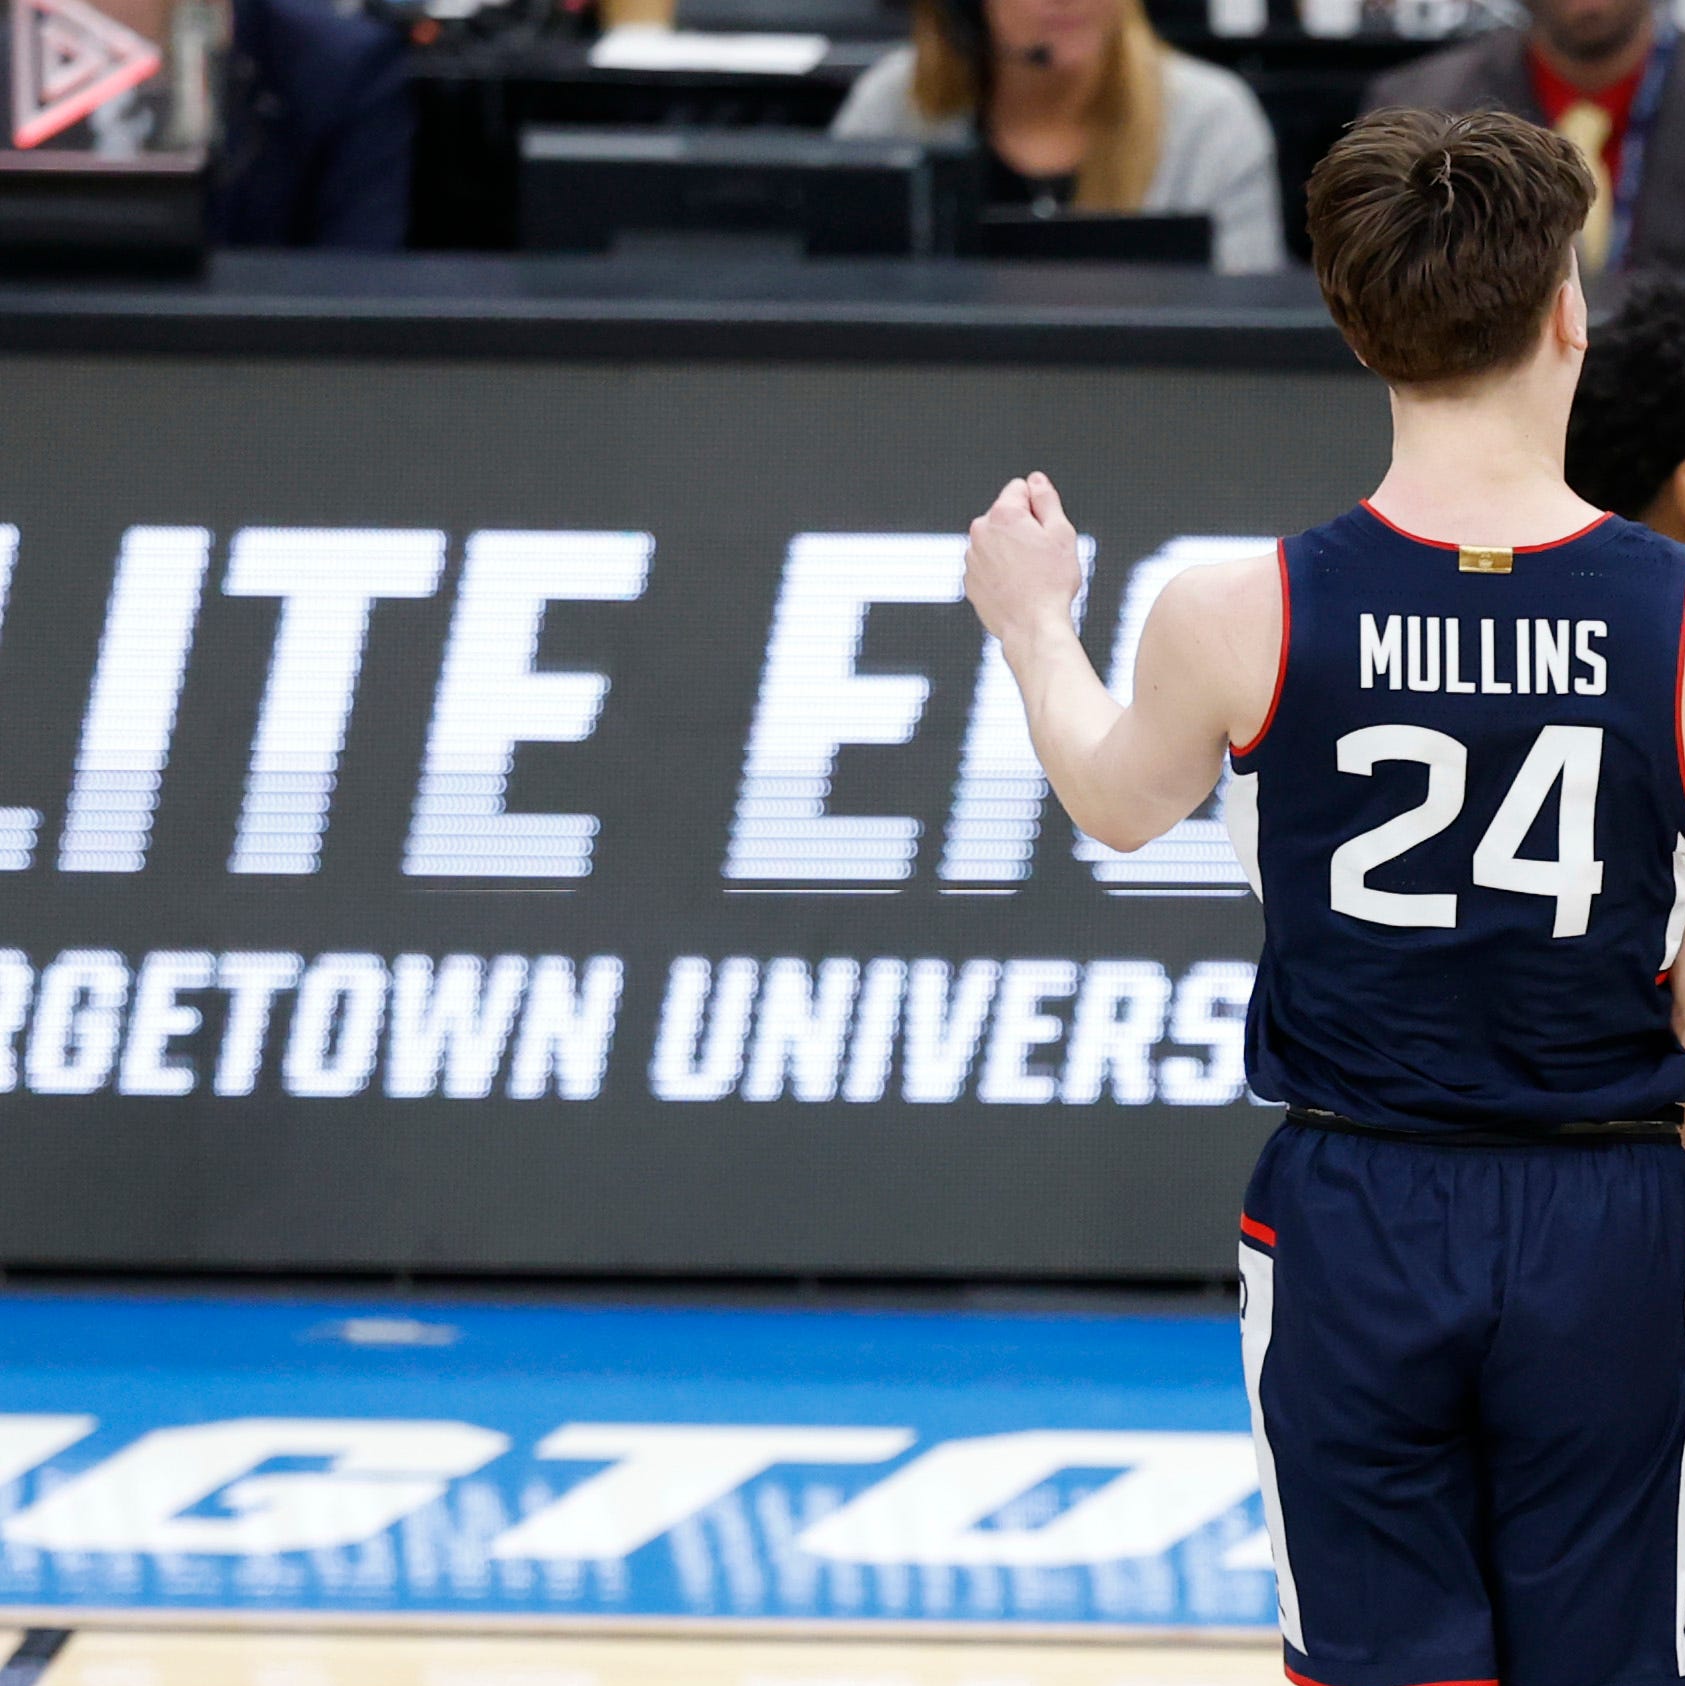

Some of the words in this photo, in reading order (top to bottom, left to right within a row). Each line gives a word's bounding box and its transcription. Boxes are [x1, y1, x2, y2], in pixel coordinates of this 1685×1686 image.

[1359, 613, 1608, 696] MULLINS
[1330, 724, 1604, 938] 24
[650, 956, 1266, 1106] UNIVERS
[0, 1414, 1275, 1568] GTO
